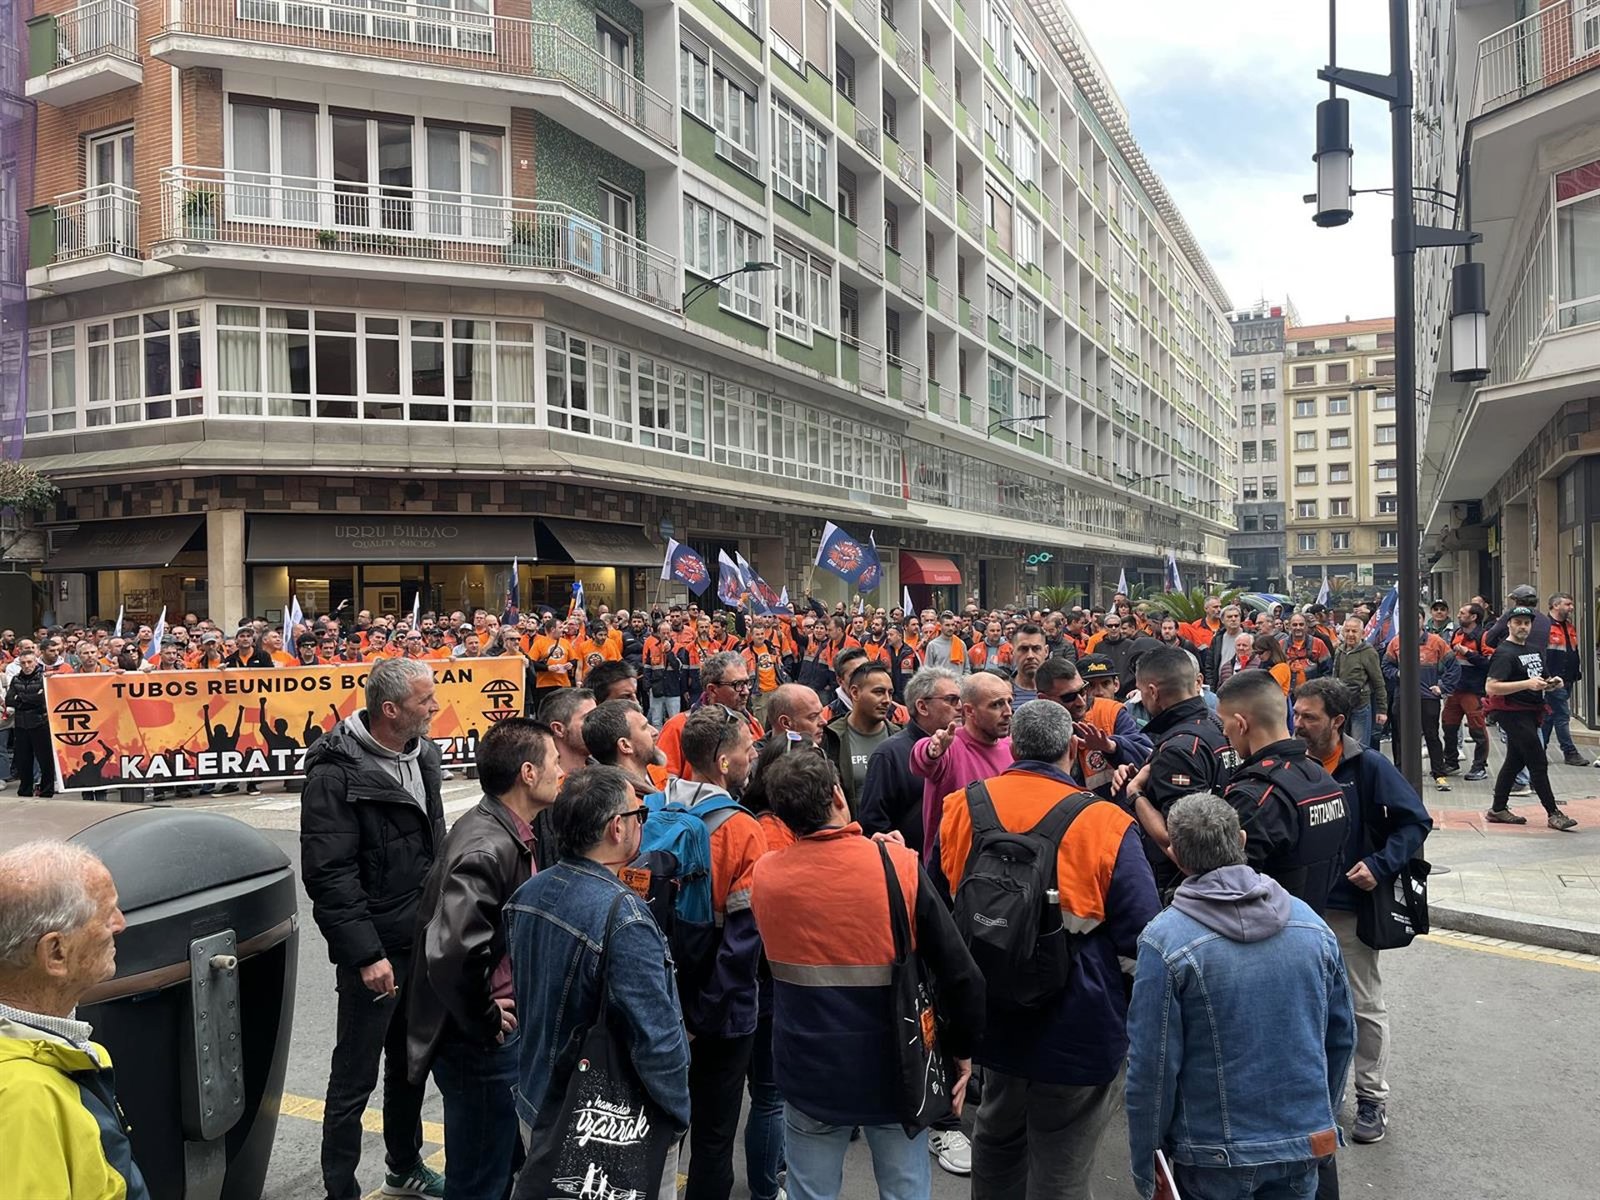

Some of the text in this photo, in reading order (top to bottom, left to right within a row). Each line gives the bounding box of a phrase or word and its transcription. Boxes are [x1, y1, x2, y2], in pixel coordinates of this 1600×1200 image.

[335, 525, 459, 538] URRU BILBAO
[352, 539, 396, 548] QUALITY
[112, 680, 198, 699] TUBOS
[207, 675, 332, 695] REUNIDOS
[486, 693, 514, 709] TR
[61, 713, 91, 731] TR
[1309, 798, 1346, 827] ERTZAINTZA
